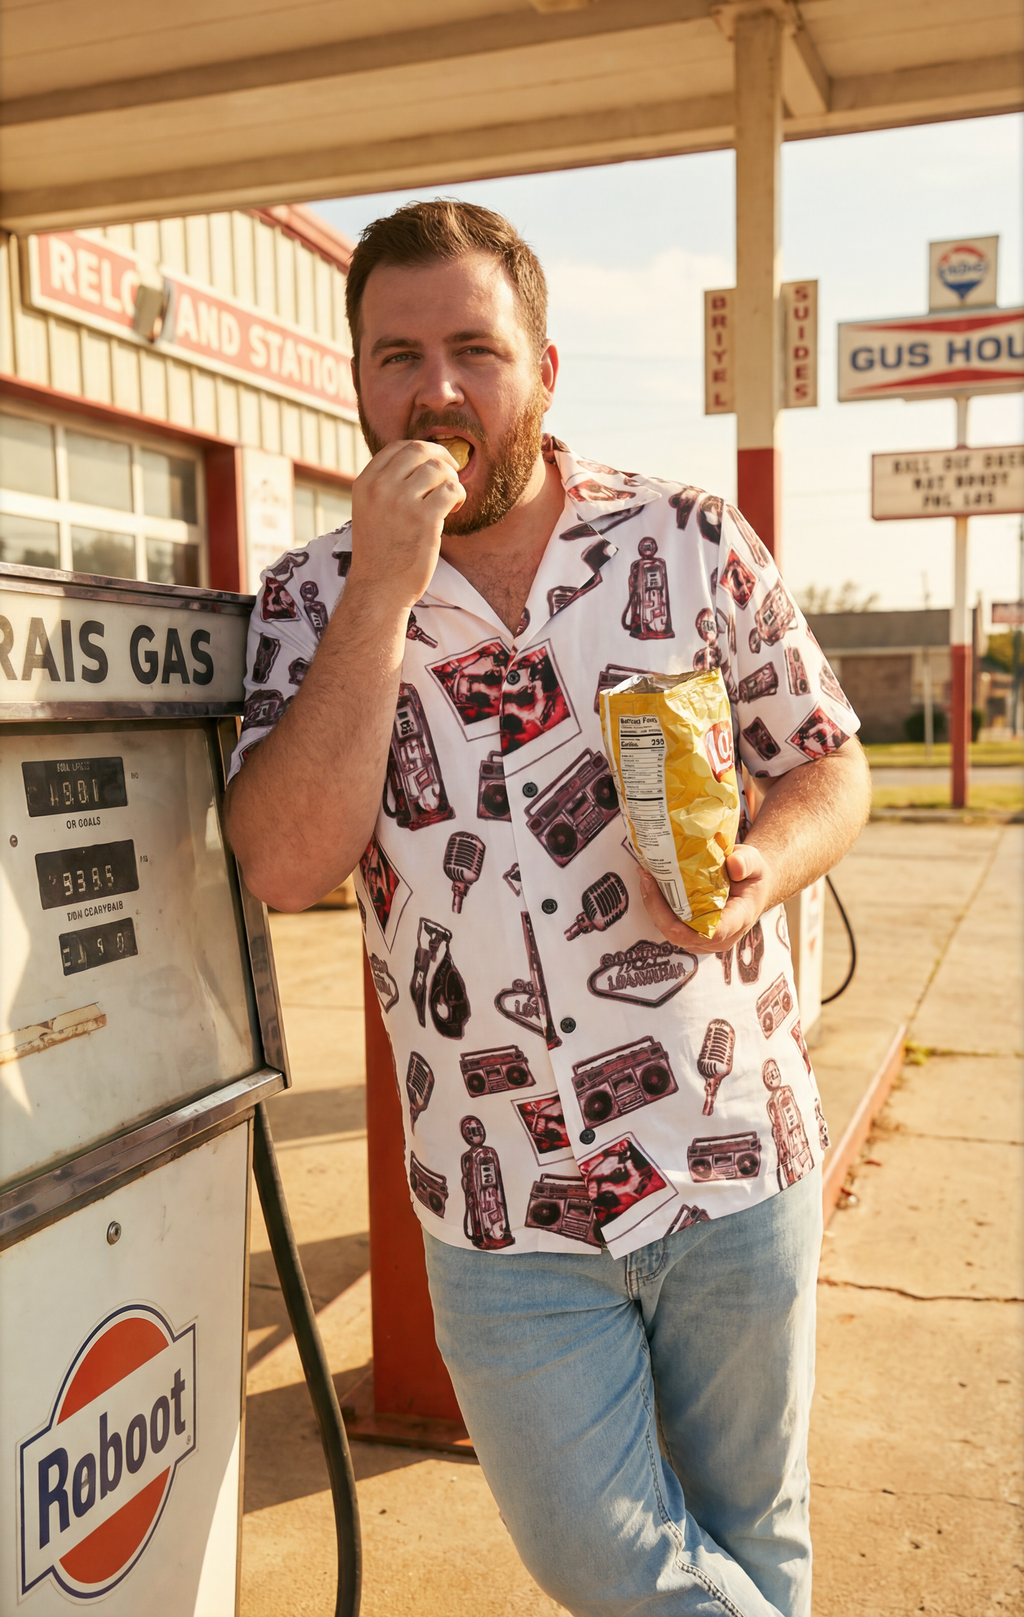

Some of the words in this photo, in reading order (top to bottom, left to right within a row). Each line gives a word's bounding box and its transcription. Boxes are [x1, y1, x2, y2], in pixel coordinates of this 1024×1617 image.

[175, 293, 241, 357] AND
[850, 341, 931, 373] GUS
[129, 624, 214, 686] GAS
[66, 819, 77, 829] OR
